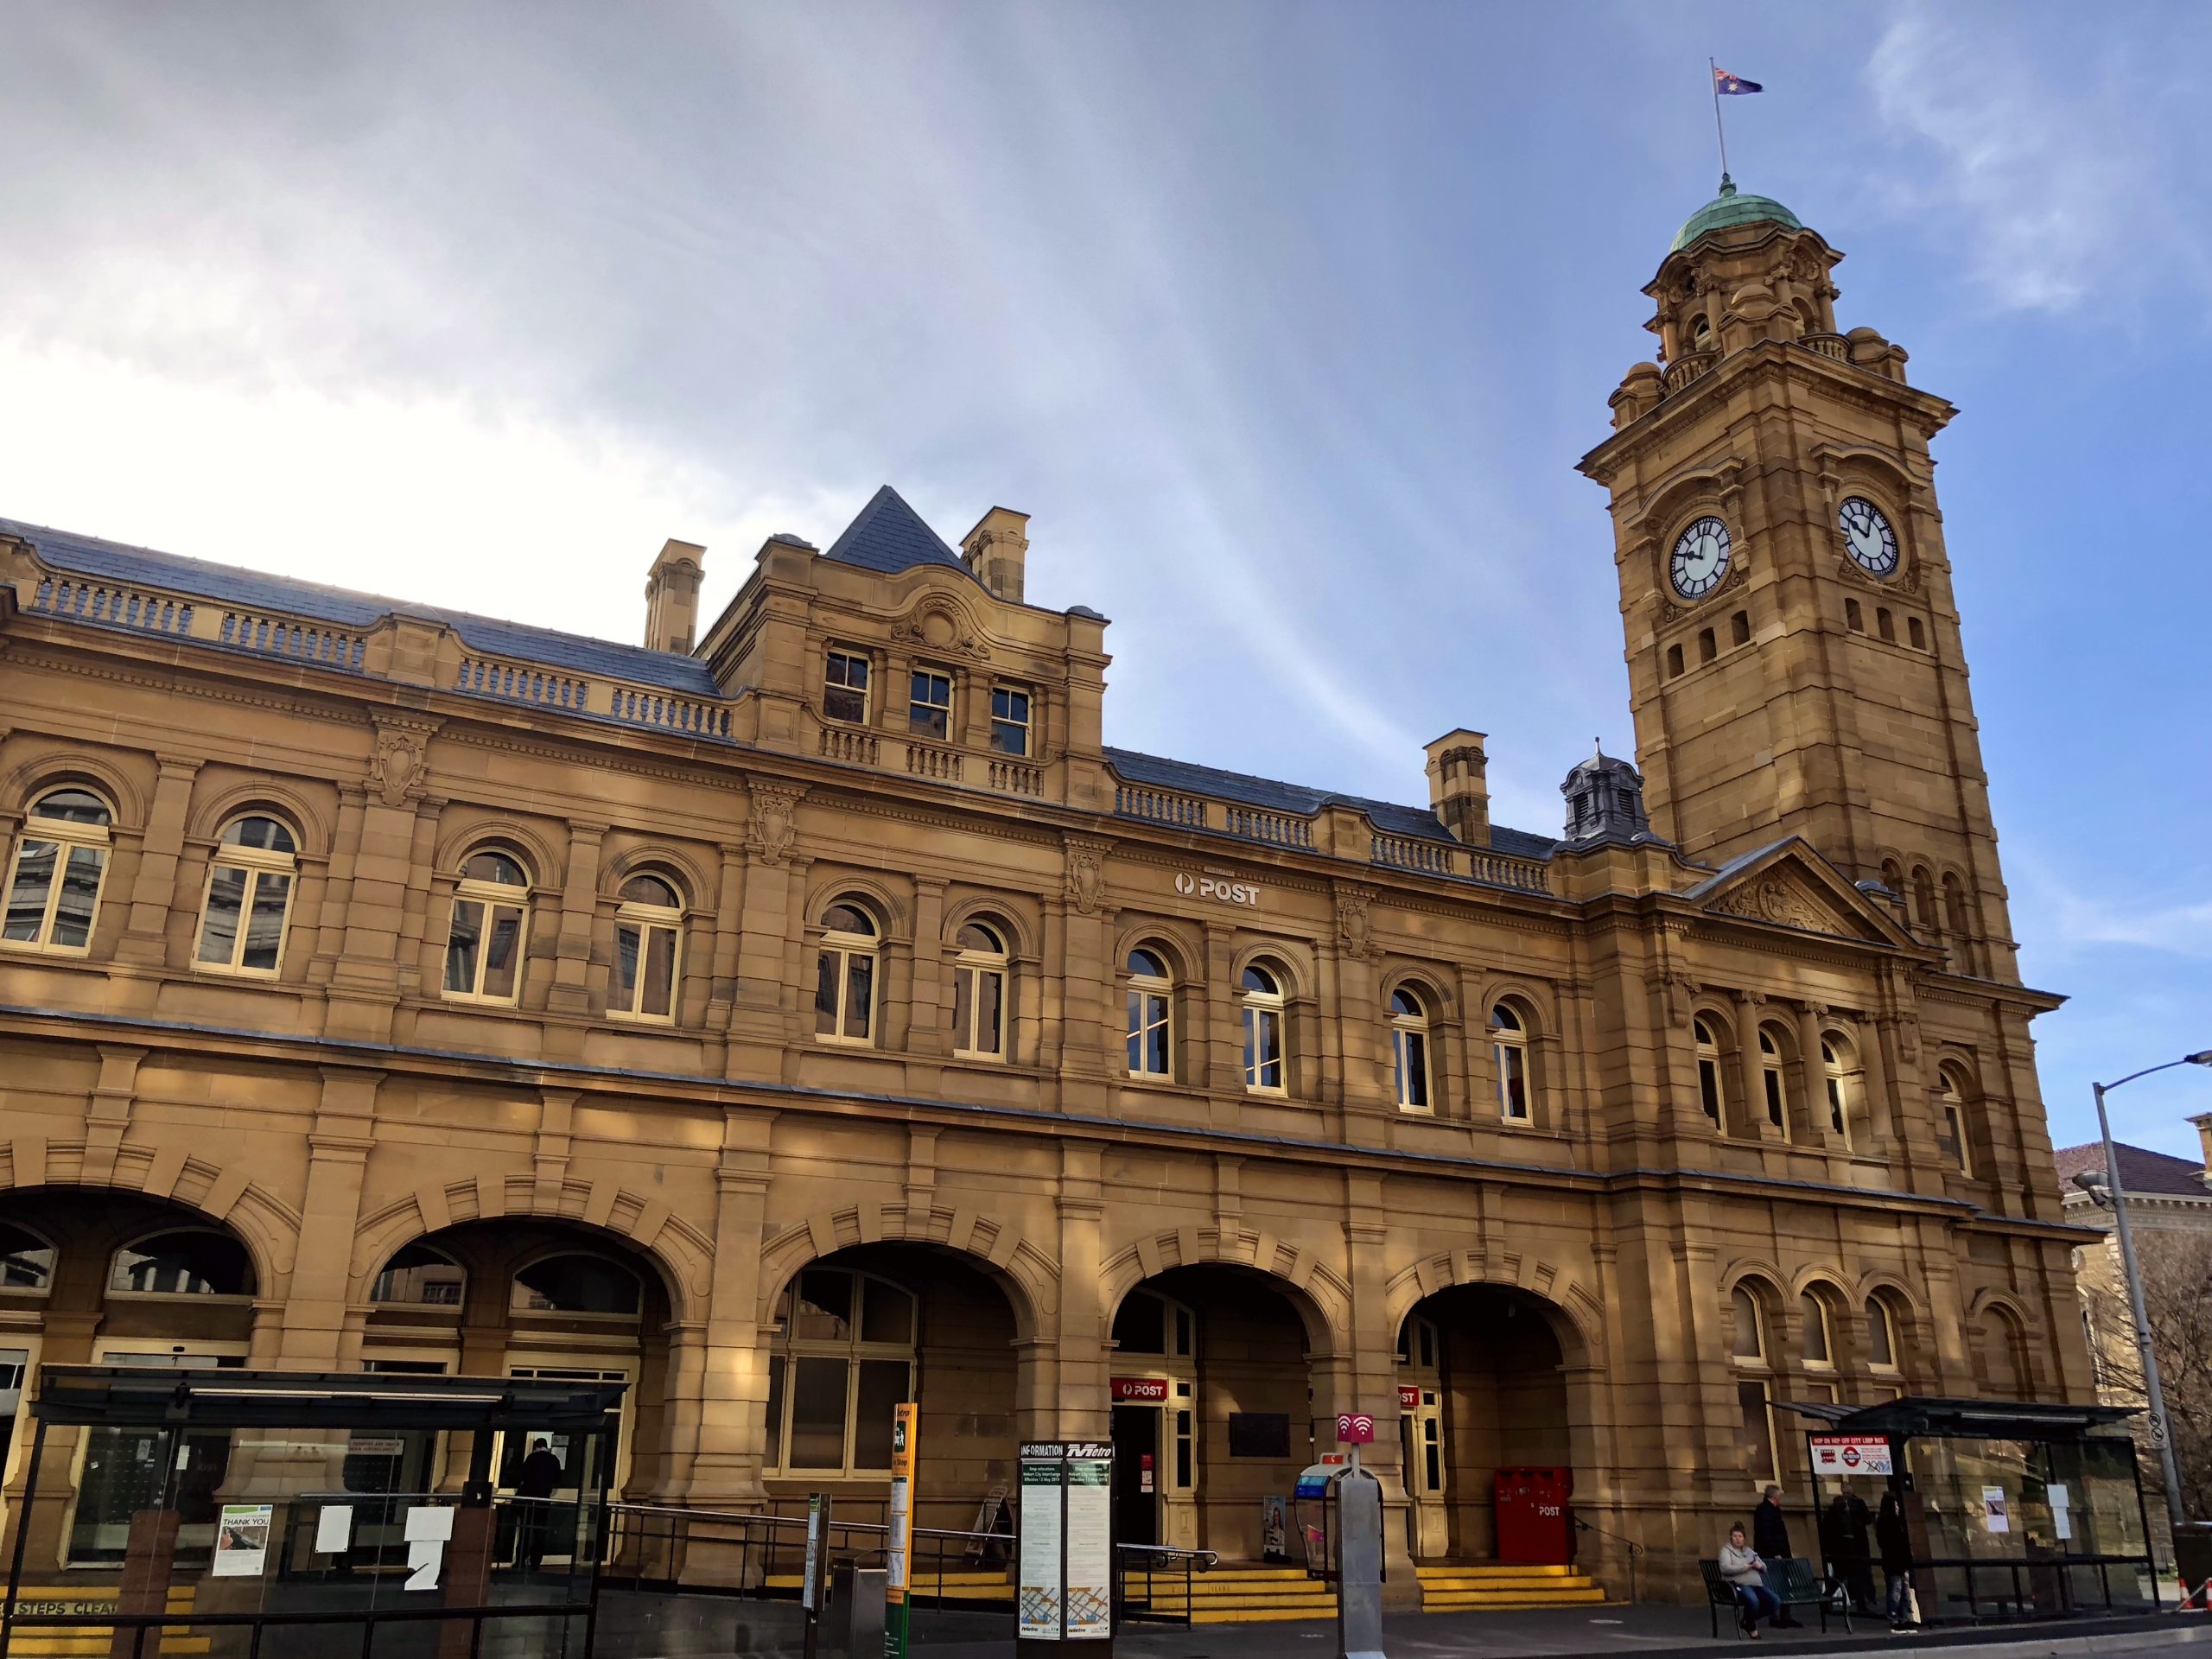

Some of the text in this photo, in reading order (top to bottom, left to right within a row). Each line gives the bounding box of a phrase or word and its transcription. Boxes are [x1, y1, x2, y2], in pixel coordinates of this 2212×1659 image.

[1199, 878, 1260, 905] POST
[1135, 1385, 1163, 1395] POST
[1021, 1445, 1063, 1456] INFORMATION
[1539, 1506, 1560, 1516] POST
[18, 1603, 67, 1614] STEPS
